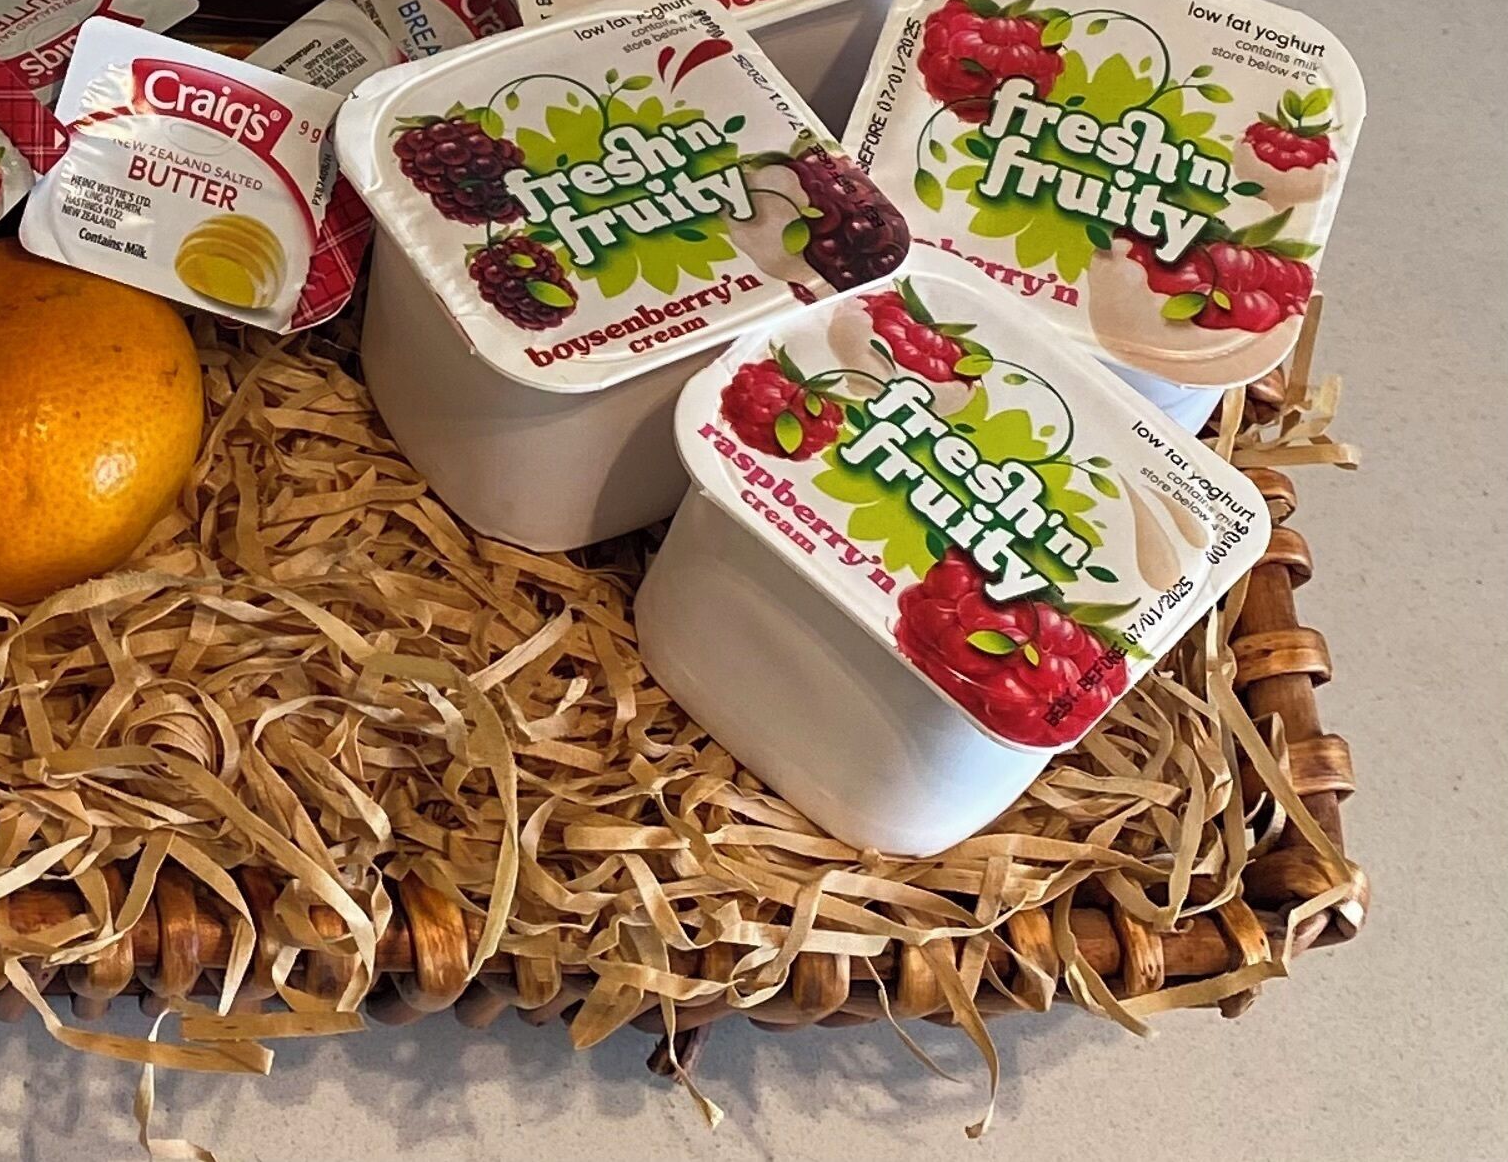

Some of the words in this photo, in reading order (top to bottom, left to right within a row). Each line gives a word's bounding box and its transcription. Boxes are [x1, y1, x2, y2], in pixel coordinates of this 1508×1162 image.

[574, 22, 604, 41] low
[622, 38, 652, 53] store
[653, 25, 688, 42] below
[877, 17, 921, 112] 07/01/2025
[1188, 1, 1222, 23] low
[1226, 14, 1251, 33] fat
[1254, 26, 1325, 57] yoghurt
[1212, 47, 1244, 63] store
[1248, 56, 1289, 76] below
[1236, 40, 1290, 63] contains
[144, 70, 272, 143] Craig's
[732, 54, 812, 140] 07/01/2025
[149, 145, 212, 174] ZEALAND
[214, 167, 263, 191] SALTED
[505, 120, 730, 221] fresh'n
[981, 77, 1229, 195] fresh'n
[128, 155, 238, 211] BUTTER
[550, 163, 756, 267] fruity
[980, 136, 1208, 262] fruity
[79, 228, 123, 252] Contains:
[526, 270, 764, 369] boysenberry'n
[629, 315, 709, 355] cream
[869, 378, 1093, 567] fresh'n
[1132, 420, 1164, 448] low
[1188, 471, 1256, 523] yoghurt
[1140, 467, 1171, 492] store
[1172, 489, 1209, 521] below
[697, 420, 898, 595] raspberry'n
[740, 488, 817, 556] cream
[839, 420, 1053, 602] fruity
[1123, 576, 1193, 645] 07/01/2025
